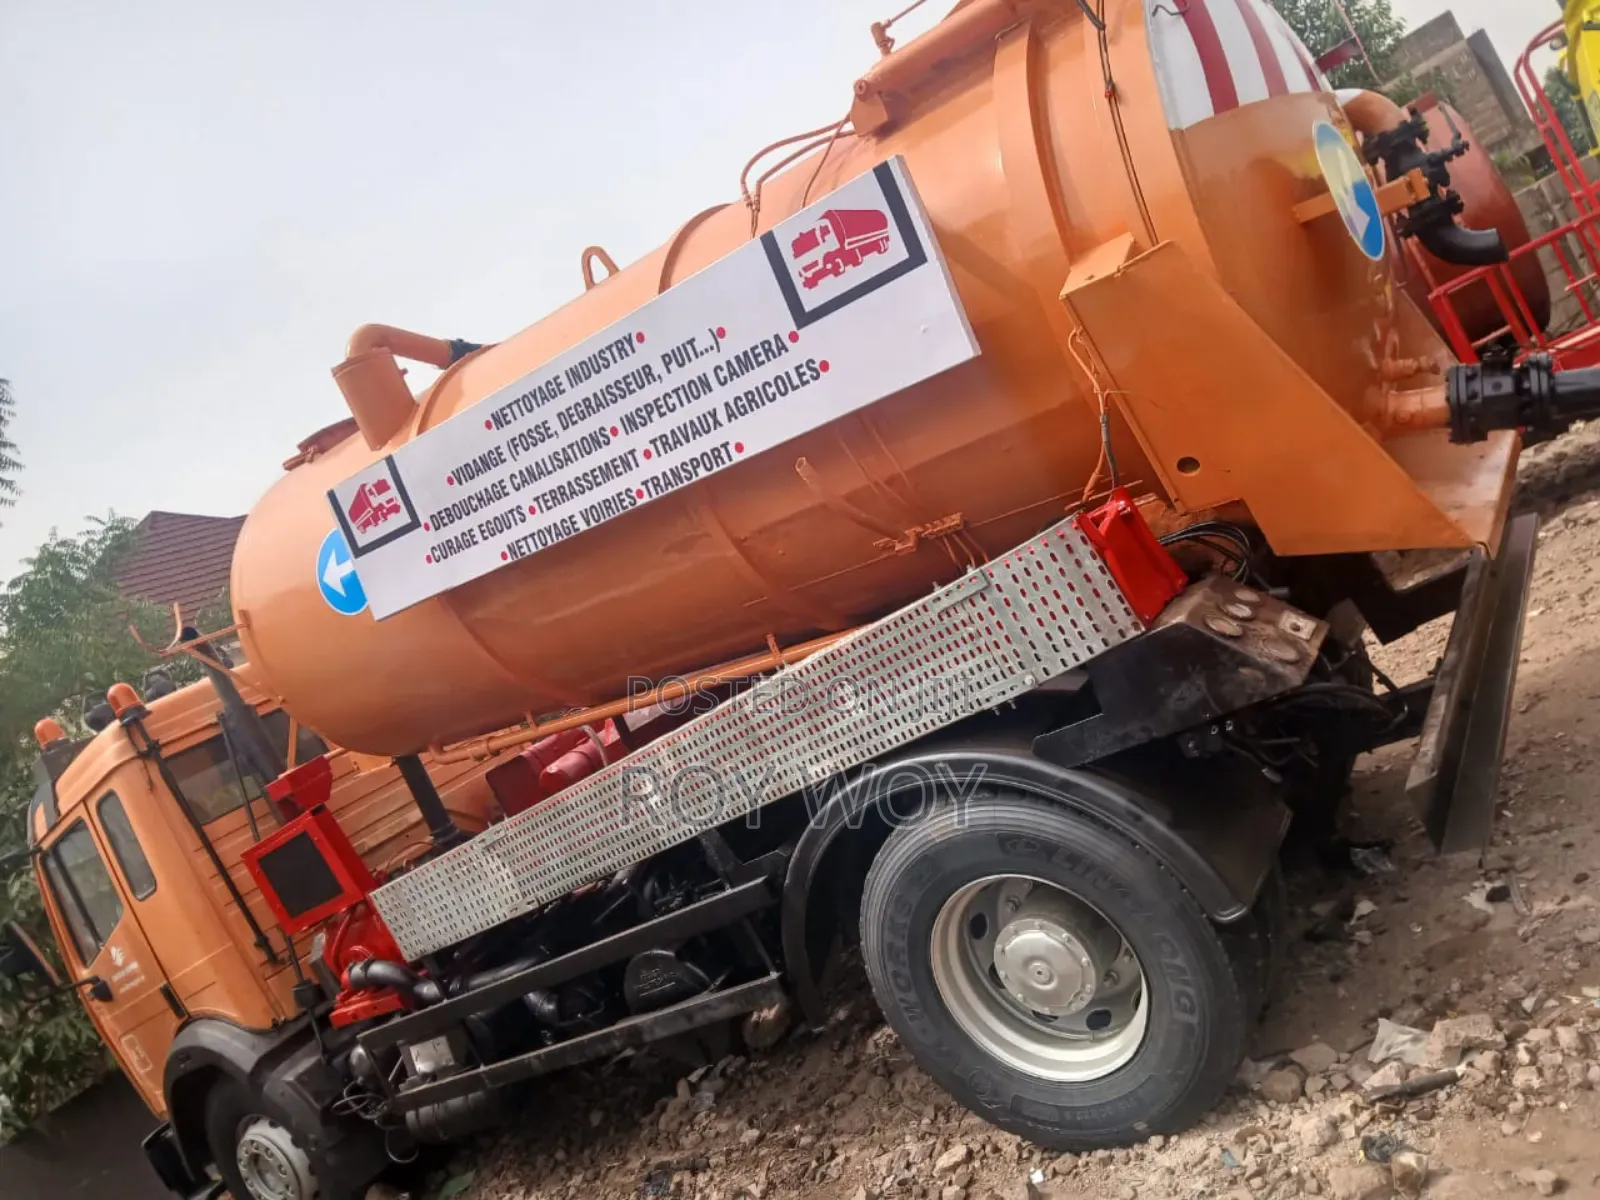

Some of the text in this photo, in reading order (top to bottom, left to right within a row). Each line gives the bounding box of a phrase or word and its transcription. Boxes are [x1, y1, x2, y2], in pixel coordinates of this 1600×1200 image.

[430, 333, 789, 531] DEBOUCHAGE CANALISATIONS INSPECTION CAMERA
[450, 328, 720, 486] VIDANGE (FOSSE, DEGRAISSEUR, PUIT...)
[491, 332, 636, 430] NETTOYAGE INDUSTRY
[431, 358, 820, 563] CURAGE EGOUTS TERRASSEMENT TRAVAUX AGRICOLES
[507, 441, 733, 560] NETTOYAGE VOIRIES TRANSPORT
